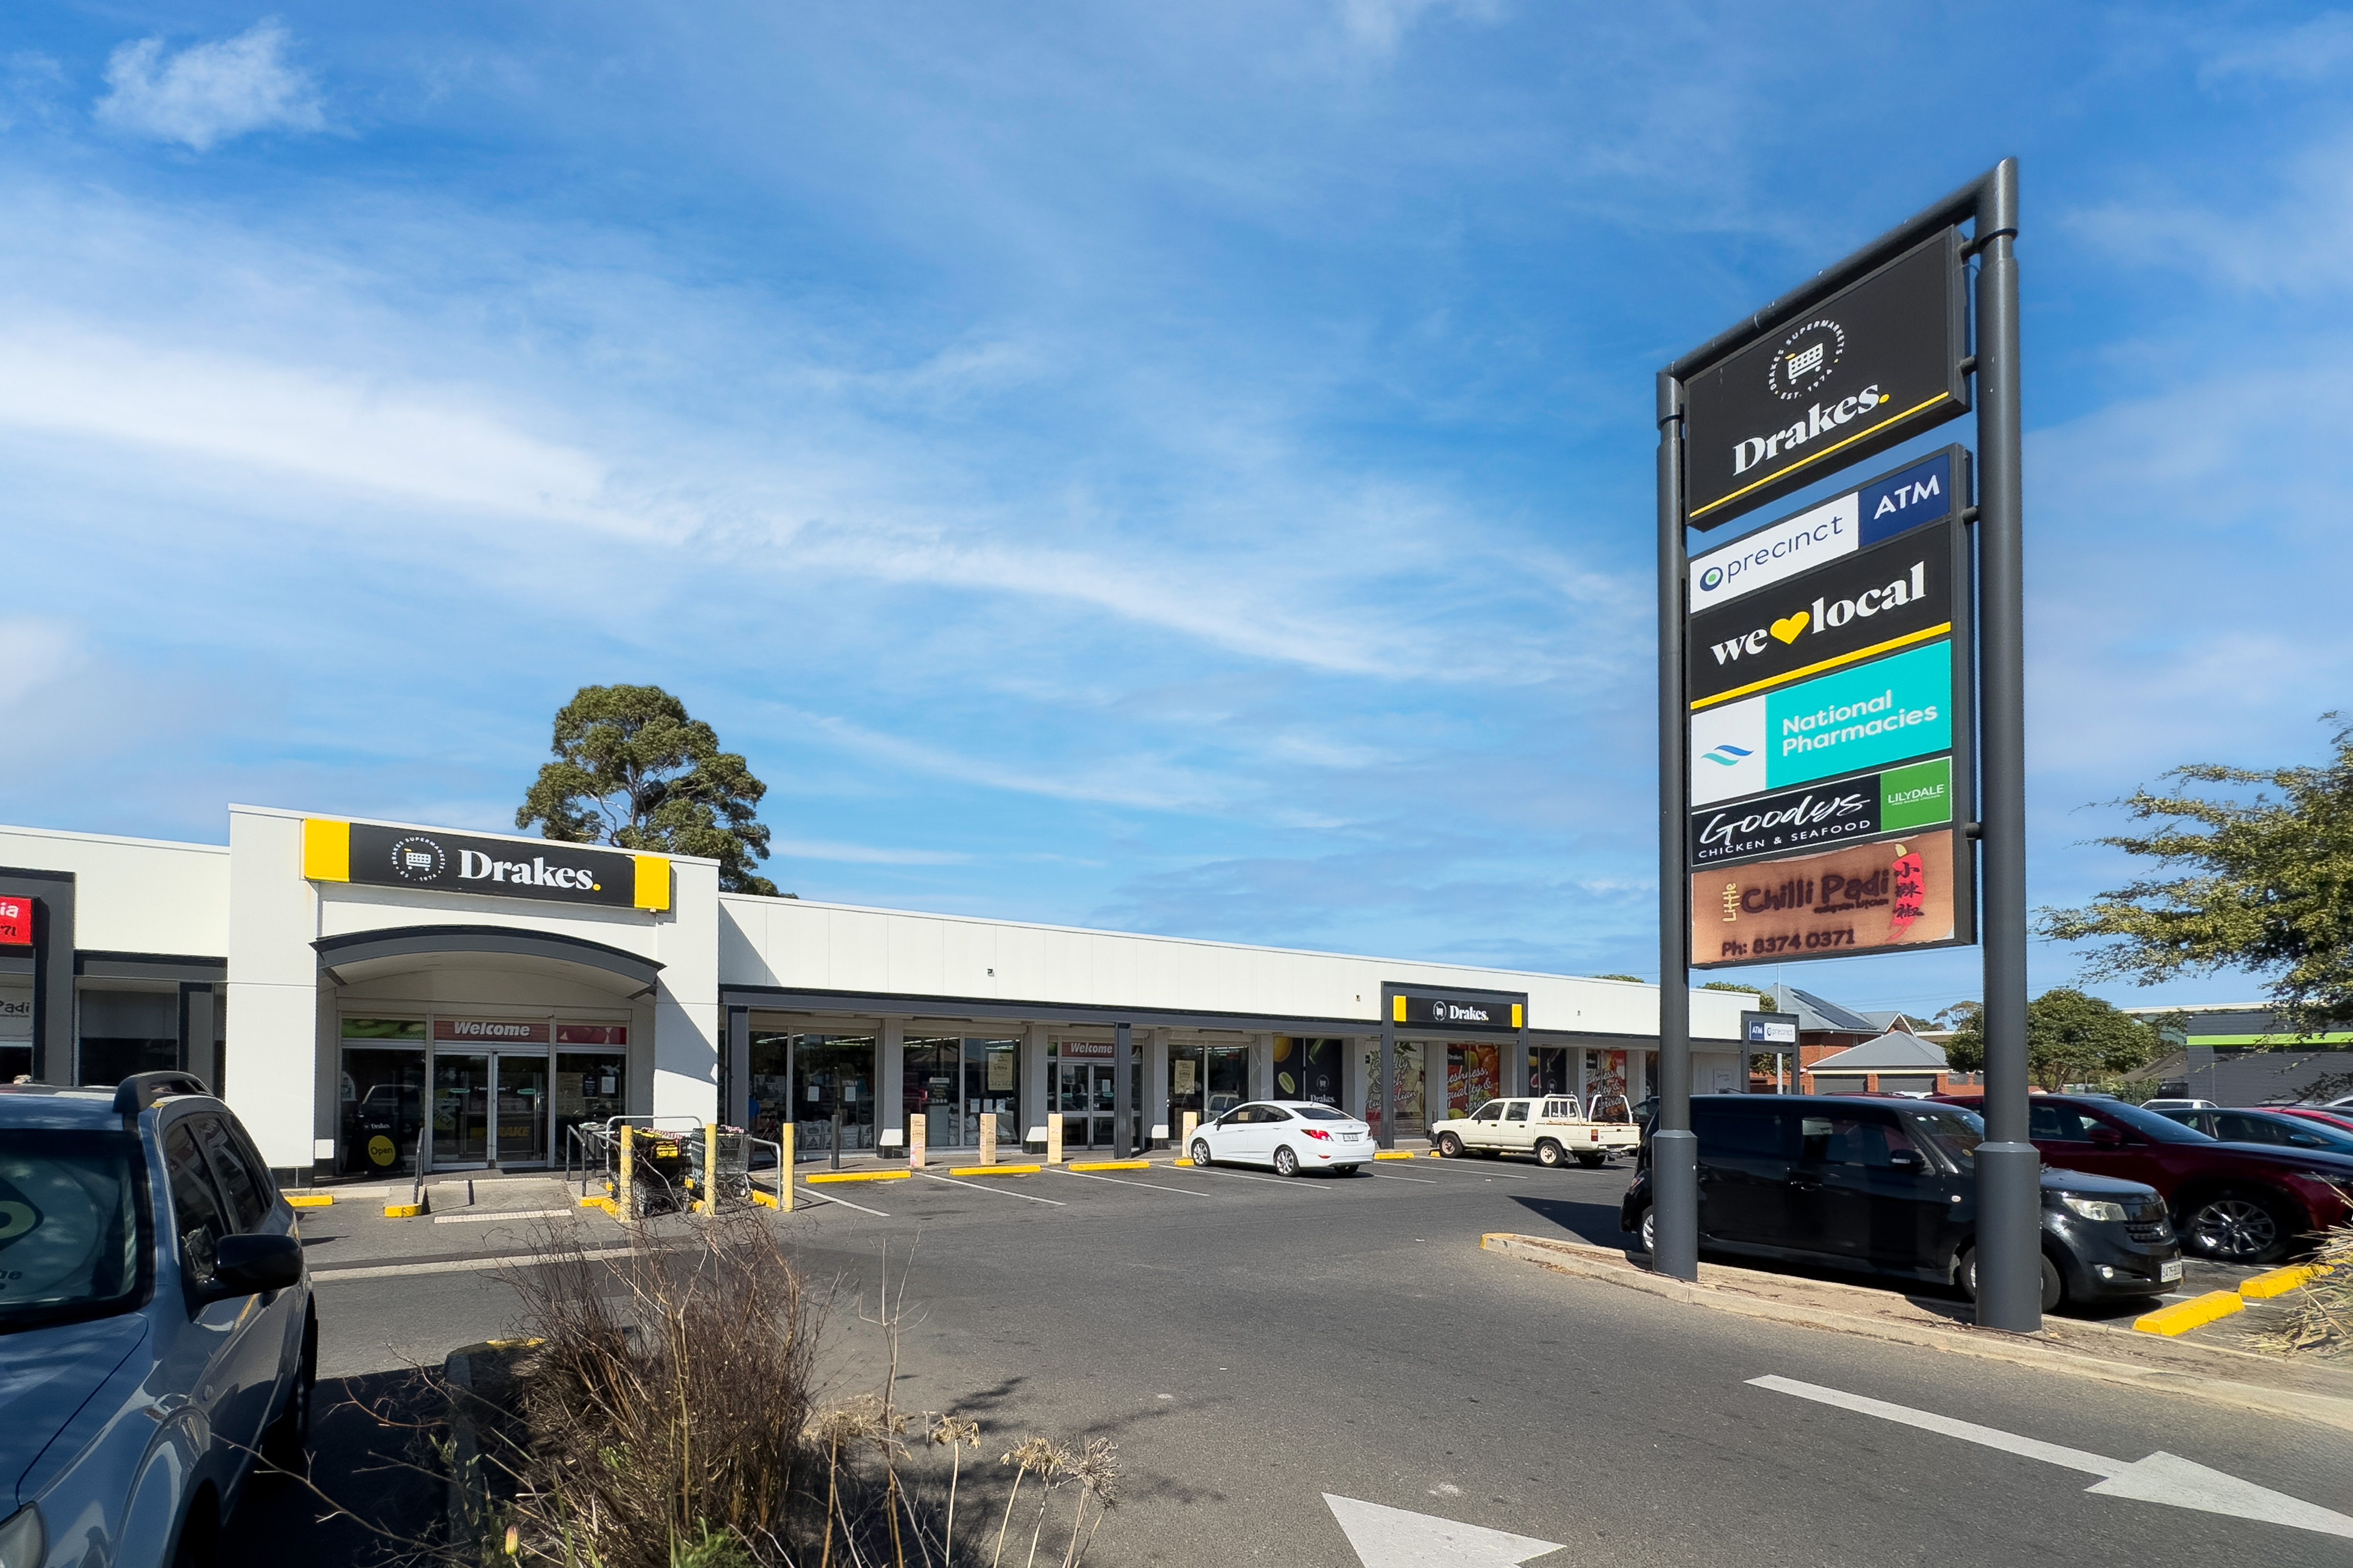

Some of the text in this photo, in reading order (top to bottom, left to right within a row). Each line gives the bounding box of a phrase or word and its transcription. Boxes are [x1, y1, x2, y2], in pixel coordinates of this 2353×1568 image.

[1786, 320, 1845, 355] SUPERMARKETS
[1733, 384, 1889, 476] Drakes.
[1873, 474, 1940, 520] ATM
[1728, 515, 1843, 583] precinct
[1710, 561, 1926, 666] we local
[1783, 689, 1893, 736] National
[1783, 705, 1938, 757] Pharmacies
[1888, 783, 1944, 803] LILYDALE
[1698, 820, 1871, 858] CHICKEN & SEAFOOD
[1699, 794, 1871, 845] Goodys
[457, 849, 601, 891] Drakes.
[1722, 882, 1741, 922] Little
[1741, 869, 1889, 913] Chilli Padi
[1722, 928, 1855, 956] Ph: 8374 0371
[454, 1021, 530, 1036] Welcome
[1449, 1005, 1489, 1021] Drakes.
[1752, 1025, 1763, 1034] ATM
[1071, 1043, 1113, 1054] Welcome
[1484, 1078, 1493, 1090] &
[370, 1146, 393, 1157] Open
